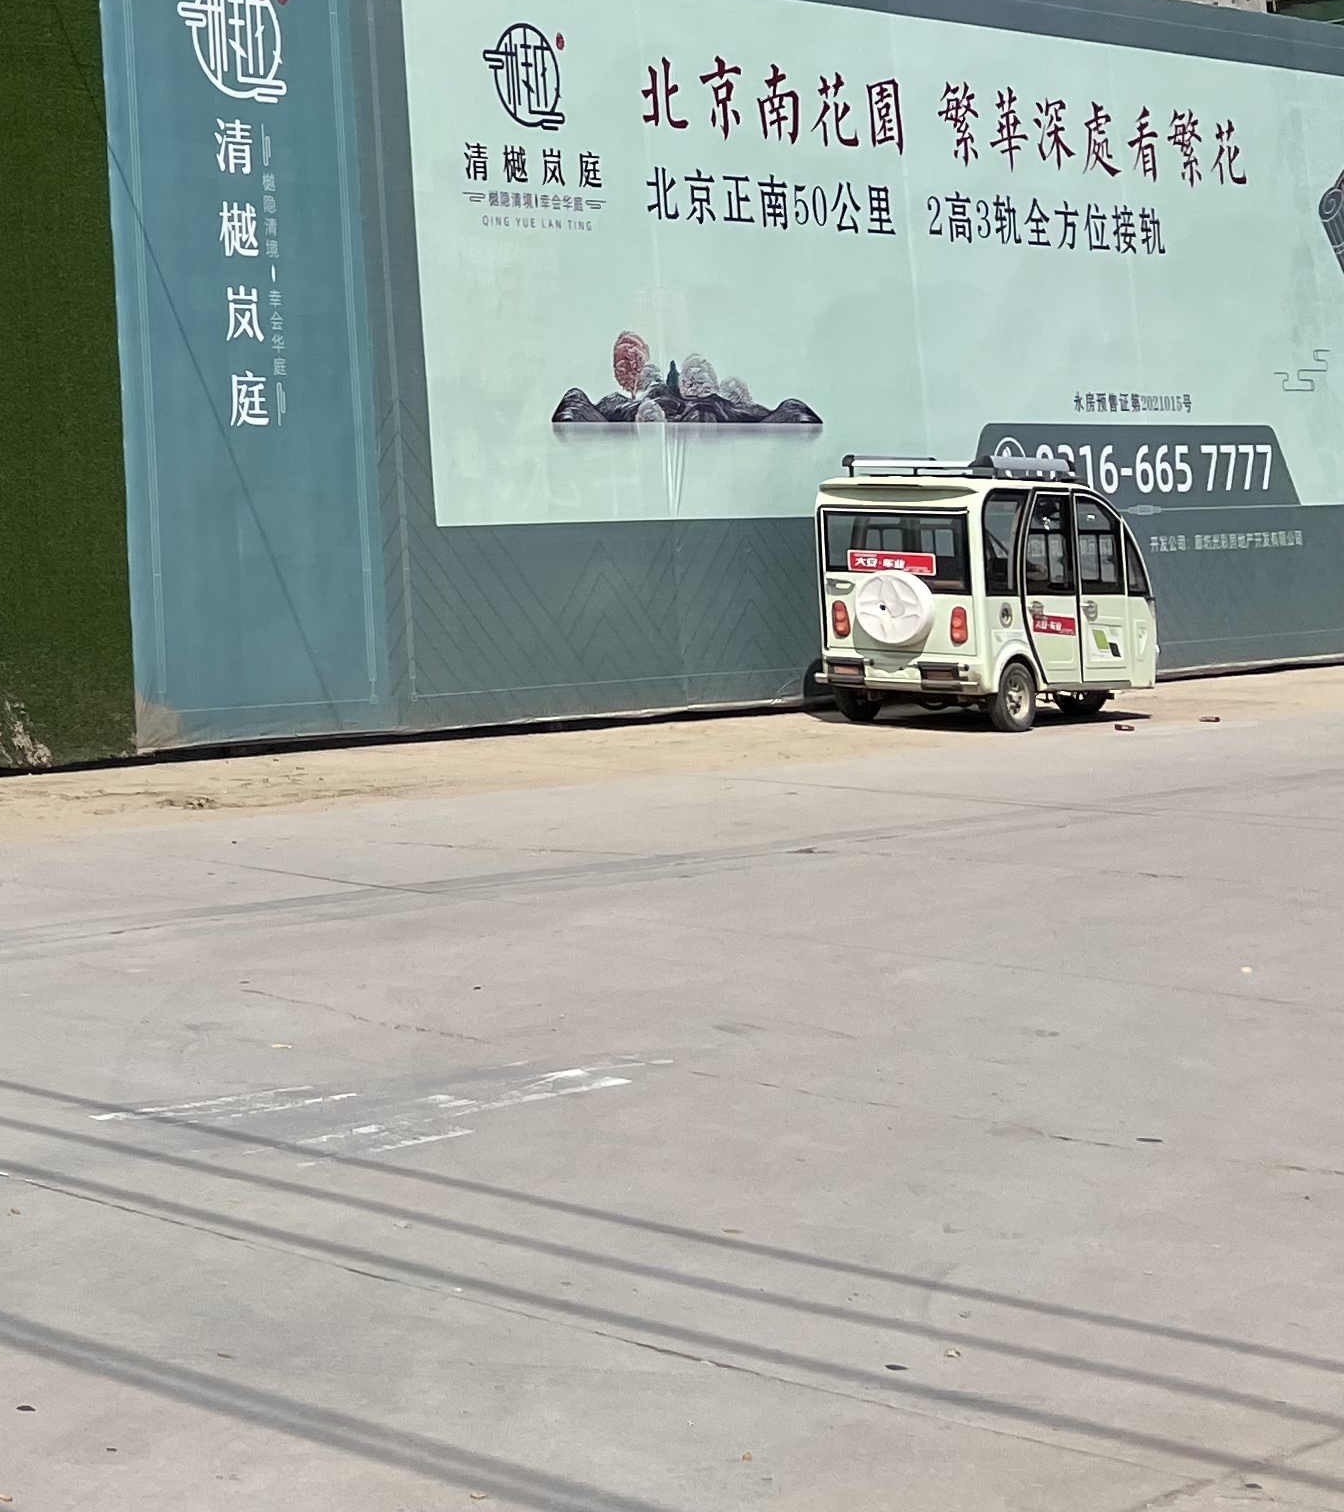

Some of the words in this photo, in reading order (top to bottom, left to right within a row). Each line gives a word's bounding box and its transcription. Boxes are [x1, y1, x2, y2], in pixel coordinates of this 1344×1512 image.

[641, 55, 905, 156] 北京南花園
[463, 142, 603, 188] 清樾岚庭
[482, 215, 510, 227] QING
[515, 217, 536, 229] YUE
[542, 219, 562, 230] LAN
[568, 220, 593, 232] TING
[646, 166, 897, 235] 北京正南50公里
[927, 191, 1166, 255] 2高3轨全方位接轨
[214, 118, 270, 427] 清樾岚庭
[1200, 444, 1272, 492] 7777
